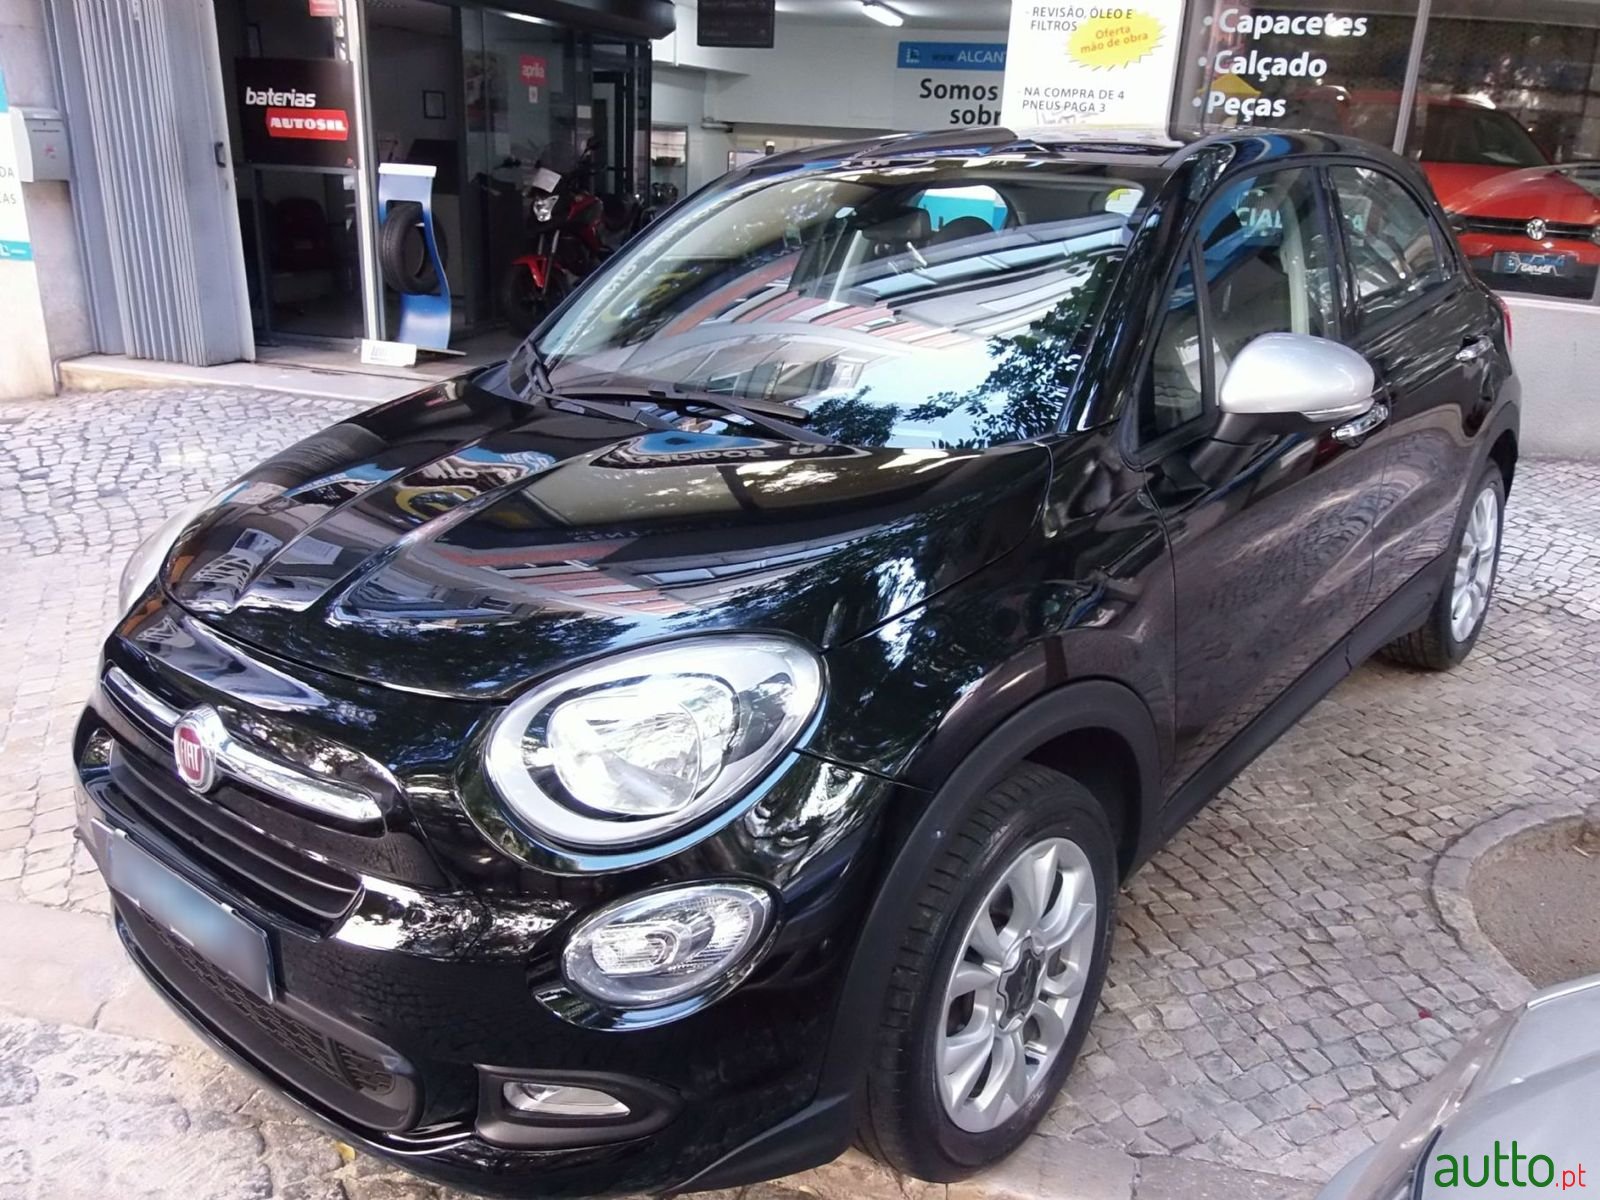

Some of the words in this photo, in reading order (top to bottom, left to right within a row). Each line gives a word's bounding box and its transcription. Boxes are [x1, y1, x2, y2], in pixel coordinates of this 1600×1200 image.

[1032, 6, 1087, 20] REVISÃO,
[1090, 7, 1121, 19] ÓLEO
[1126, 9, 1133, 19] E
[1218, 8, 1368, 40] Capacetes
[1031, 20, 1078, 32] FILTROS
[1095, 25, 1131, 40] Oferta
[1080, 40, 1105, 54] mão
[1107, 37, 1121, 48] de
[1123, 32, 1149, 44] obra
[1214, 50, 1328, 82] Calçado
[245, 86, 317, 108] baterias
[919, 78, 999, 101] Somos
[1024, 87, 1041, 97] NA
[1044, 87, 1095, 99] COMPRA
[1099, 89, 1115, 100] DE
[1117, 90, 1125, 100] 4
[1022, 100, 1061, 111] PNEUS
[1063, 100, 1096, 112] PAGA
[1099, 103, 1106, 113] 3
[1206, 91, 1287, 122] Peças
[270, 117, 347, 131] AUTOSIL
[180, 737, 201, 772] FIAT
